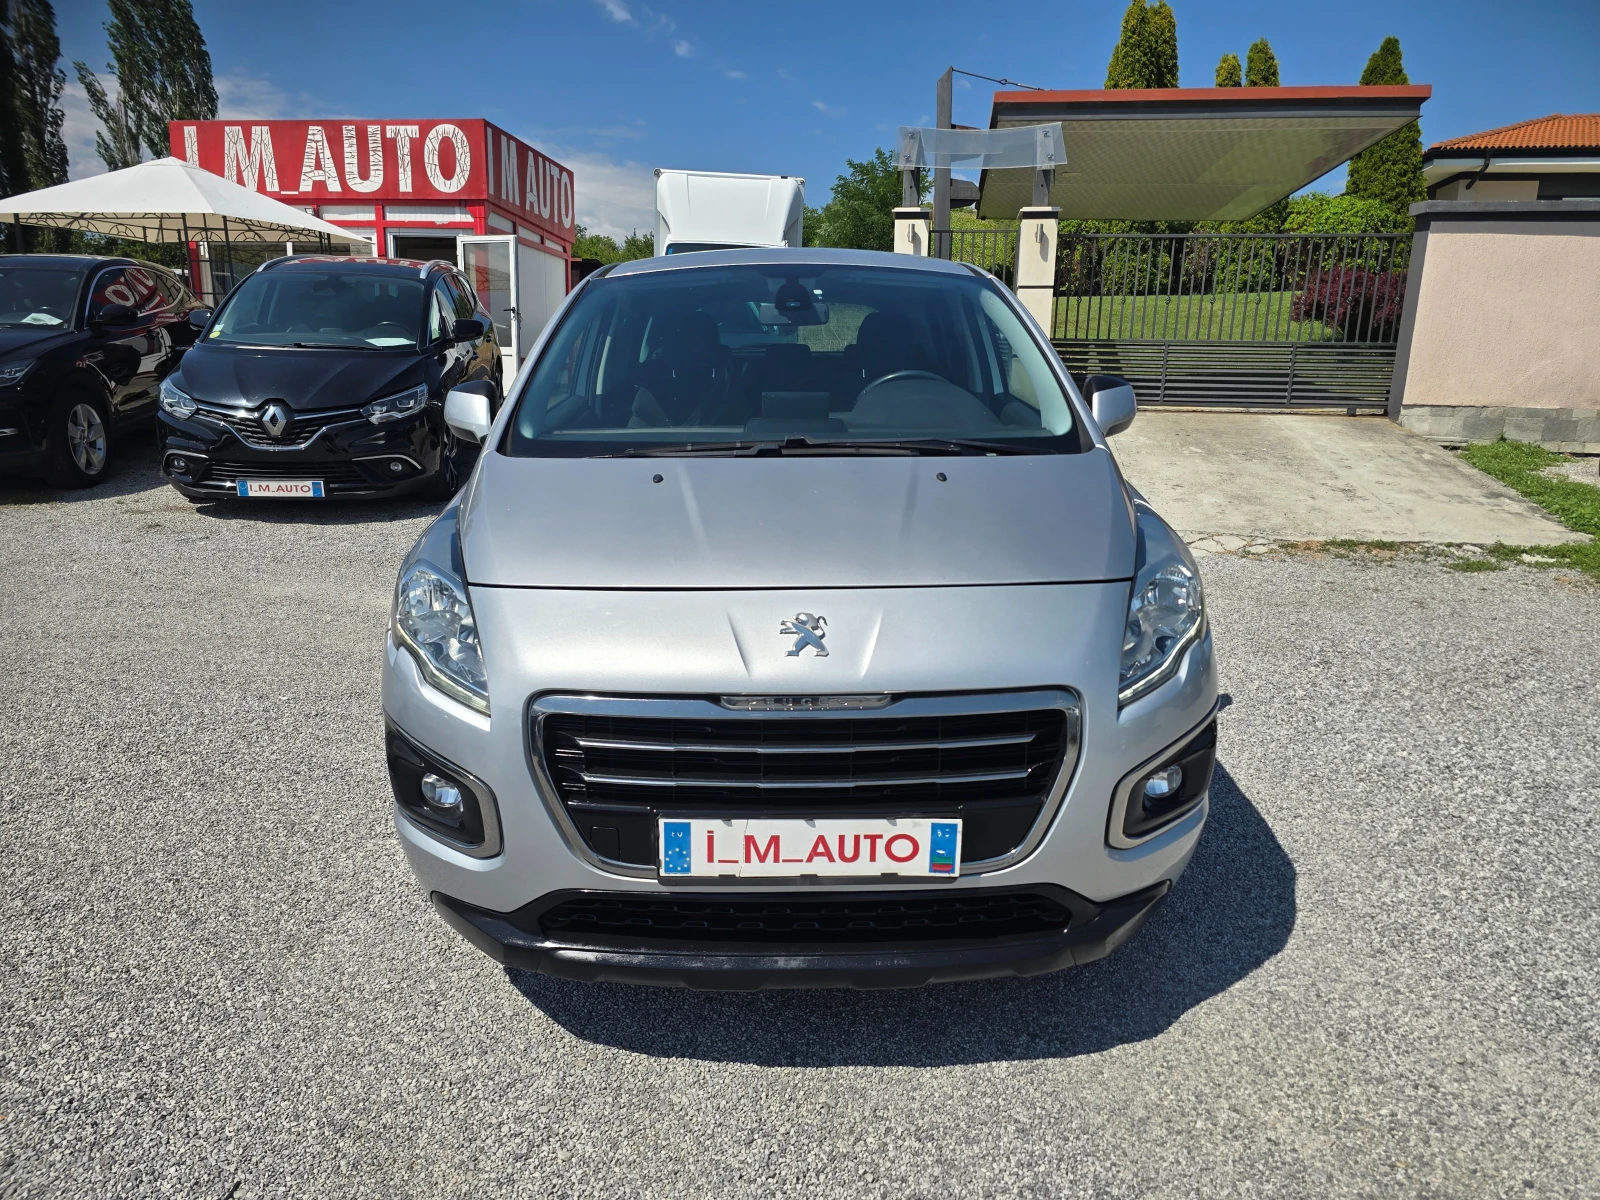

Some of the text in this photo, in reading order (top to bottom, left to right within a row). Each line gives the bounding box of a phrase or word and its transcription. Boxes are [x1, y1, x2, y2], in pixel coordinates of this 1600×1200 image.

[486, 126, 573, 229] I M AUTO
